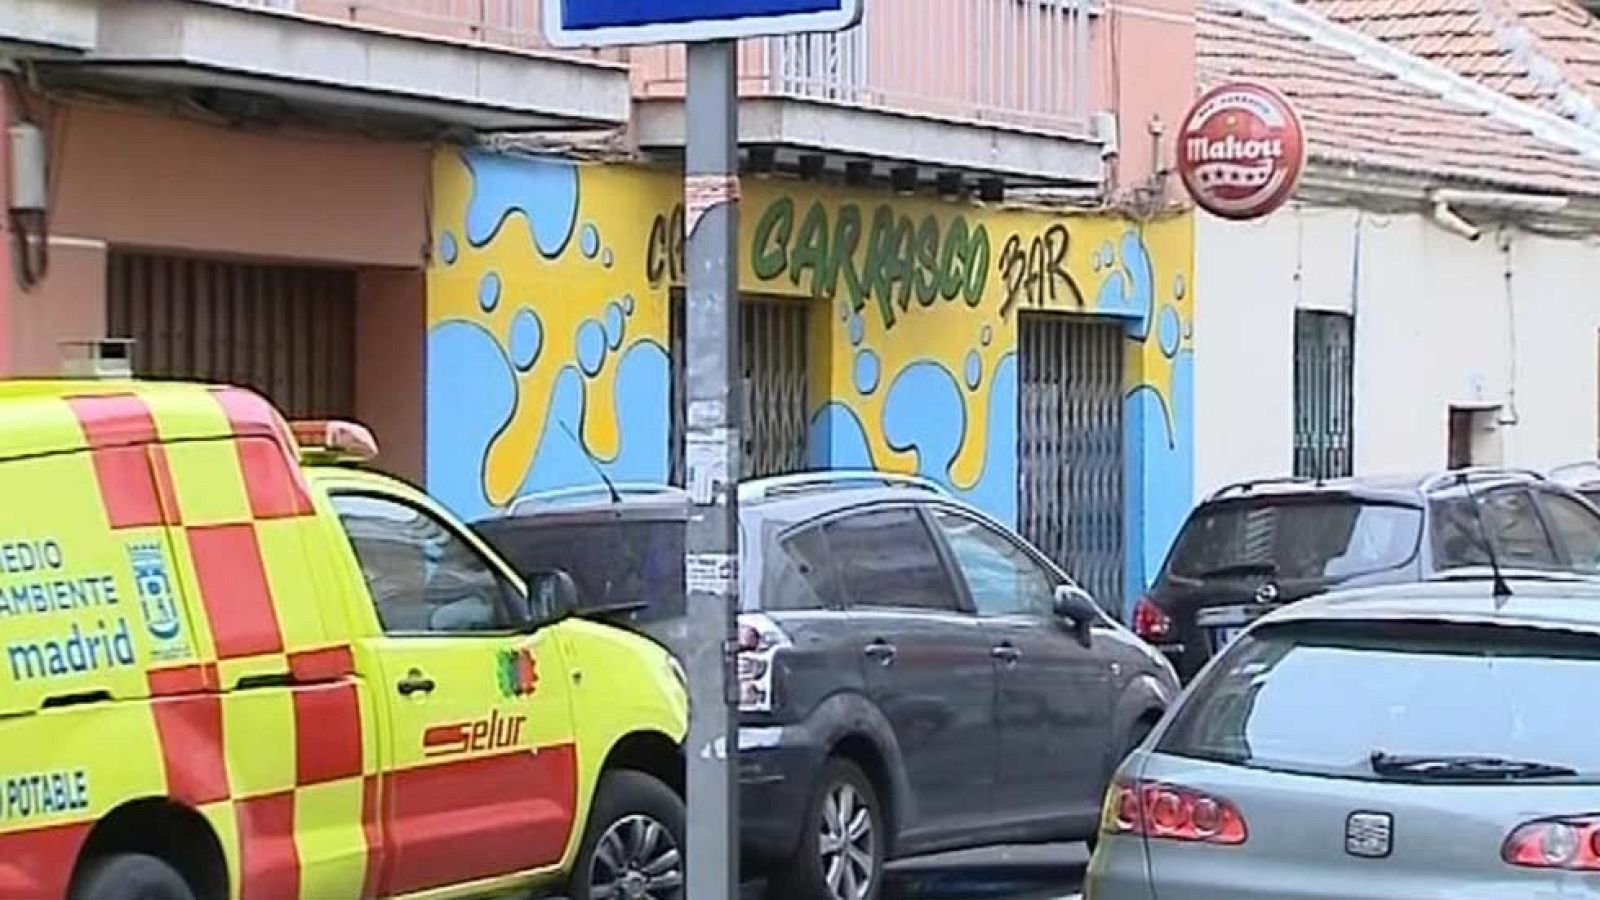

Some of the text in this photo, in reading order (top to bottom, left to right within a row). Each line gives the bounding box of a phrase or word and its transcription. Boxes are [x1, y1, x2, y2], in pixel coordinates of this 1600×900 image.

[1186, 135, 1282, 161] Mahou
[752, 196, 991, 329] CARRASCO
[999, 224, 1083, 317] BAR
[0, 541, 62, 573] EDIO
[8, 619, 134, 680] madrid
[7, 771, 88, 818] POTABLE
